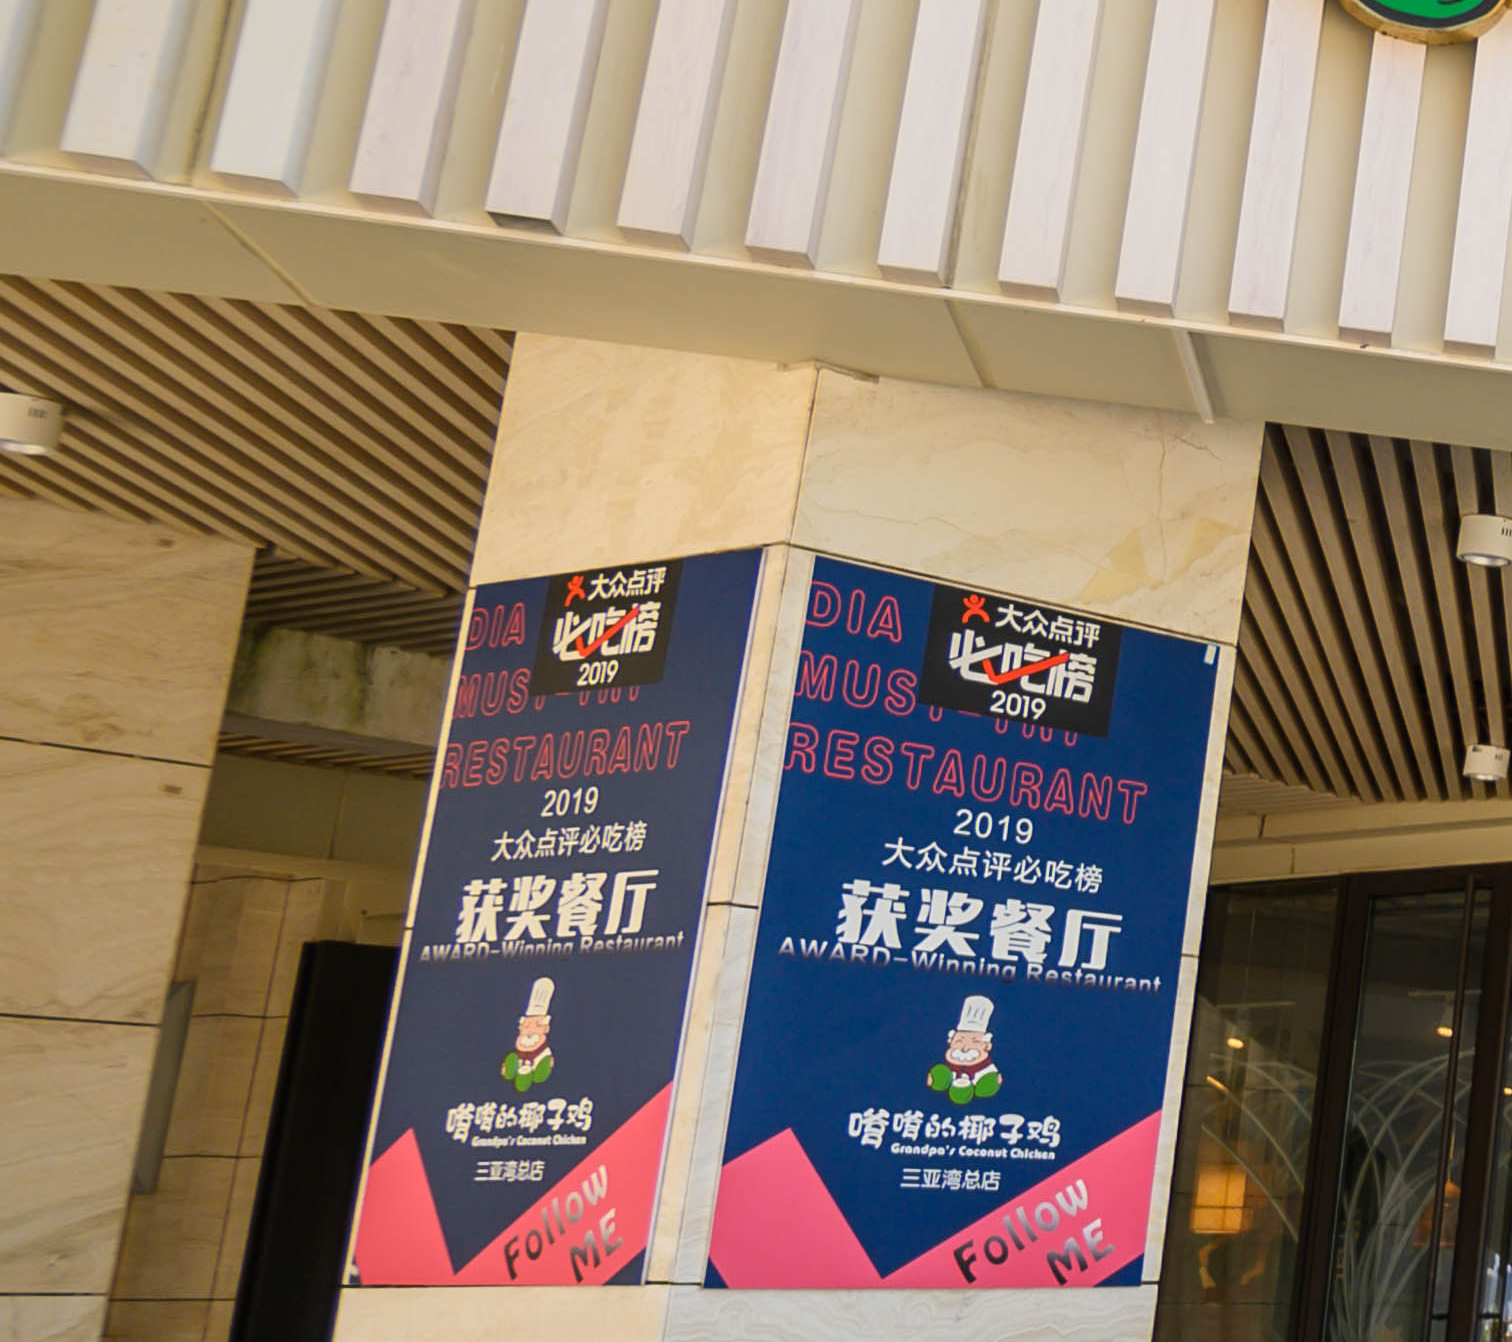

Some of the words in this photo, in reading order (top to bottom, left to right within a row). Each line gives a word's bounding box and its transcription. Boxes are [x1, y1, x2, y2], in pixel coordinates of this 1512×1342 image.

[587, 567, 667, 601] 大众点评
[552, 601, 662, 662] 必吃榜
[995, 604, 1101, 649] 大众点评
[576, 660, 619, 686] 2019
[949, 629, 1098, 704] 必吃榜
[990, 690, 1046, 720] 2019
[440, 720, 690, 789] RESTAURANT
[784, 722, 1148, 824] RESTAURANT
[540, 786, 600, 818] 2019
[491, 820, 648, 862] 大众点评必吃榜
[953, 808, 1034, 844] 2019
[881, 837, 1104, 894] 大众点评必吃榜
[456, 869, 660, 943] 获奖餐厅
[834, 879, 1124, 971] 获奖餐厅
[580, 930, 685, 955] Restaurant
[778, 936, 1017, 984] AWARD-Winning
[1024, 961, 1162, 994] Restaurant
[848, 1108, 1062, 1149] 嗲嗲的椰子鸡
[474, 1160, 546, 1182] 三亚湾总店
[900, 1168, 1001, 1191] 三亚湾总店
[569, 1208, 625, 1284] ME
[1045, 1218, 1116, 1285] ME
